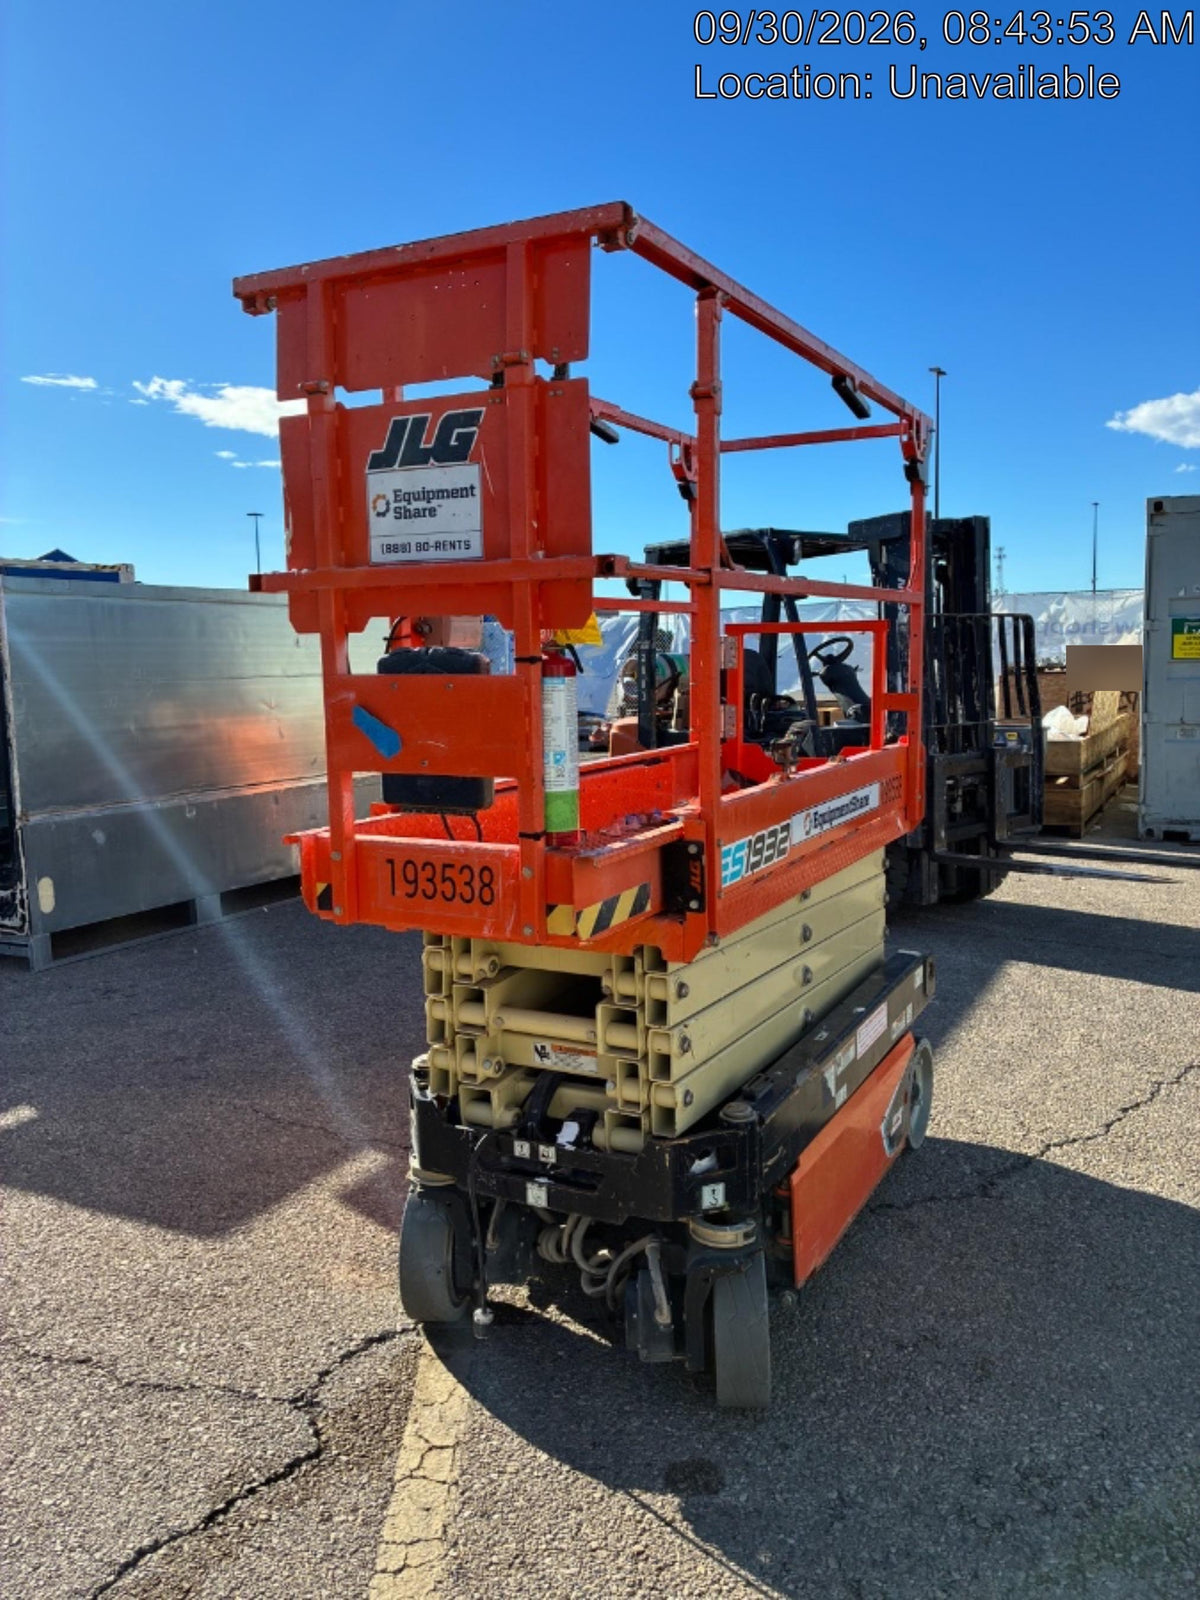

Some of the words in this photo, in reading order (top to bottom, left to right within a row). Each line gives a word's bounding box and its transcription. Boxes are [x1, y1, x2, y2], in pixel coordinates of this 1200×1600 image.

[366, 407, 486, 473] JLG
[393, 483, 477, 506] Equipment
[386, 858, 496, 906] 193538
[721, 821, 792, 887] ES1932
